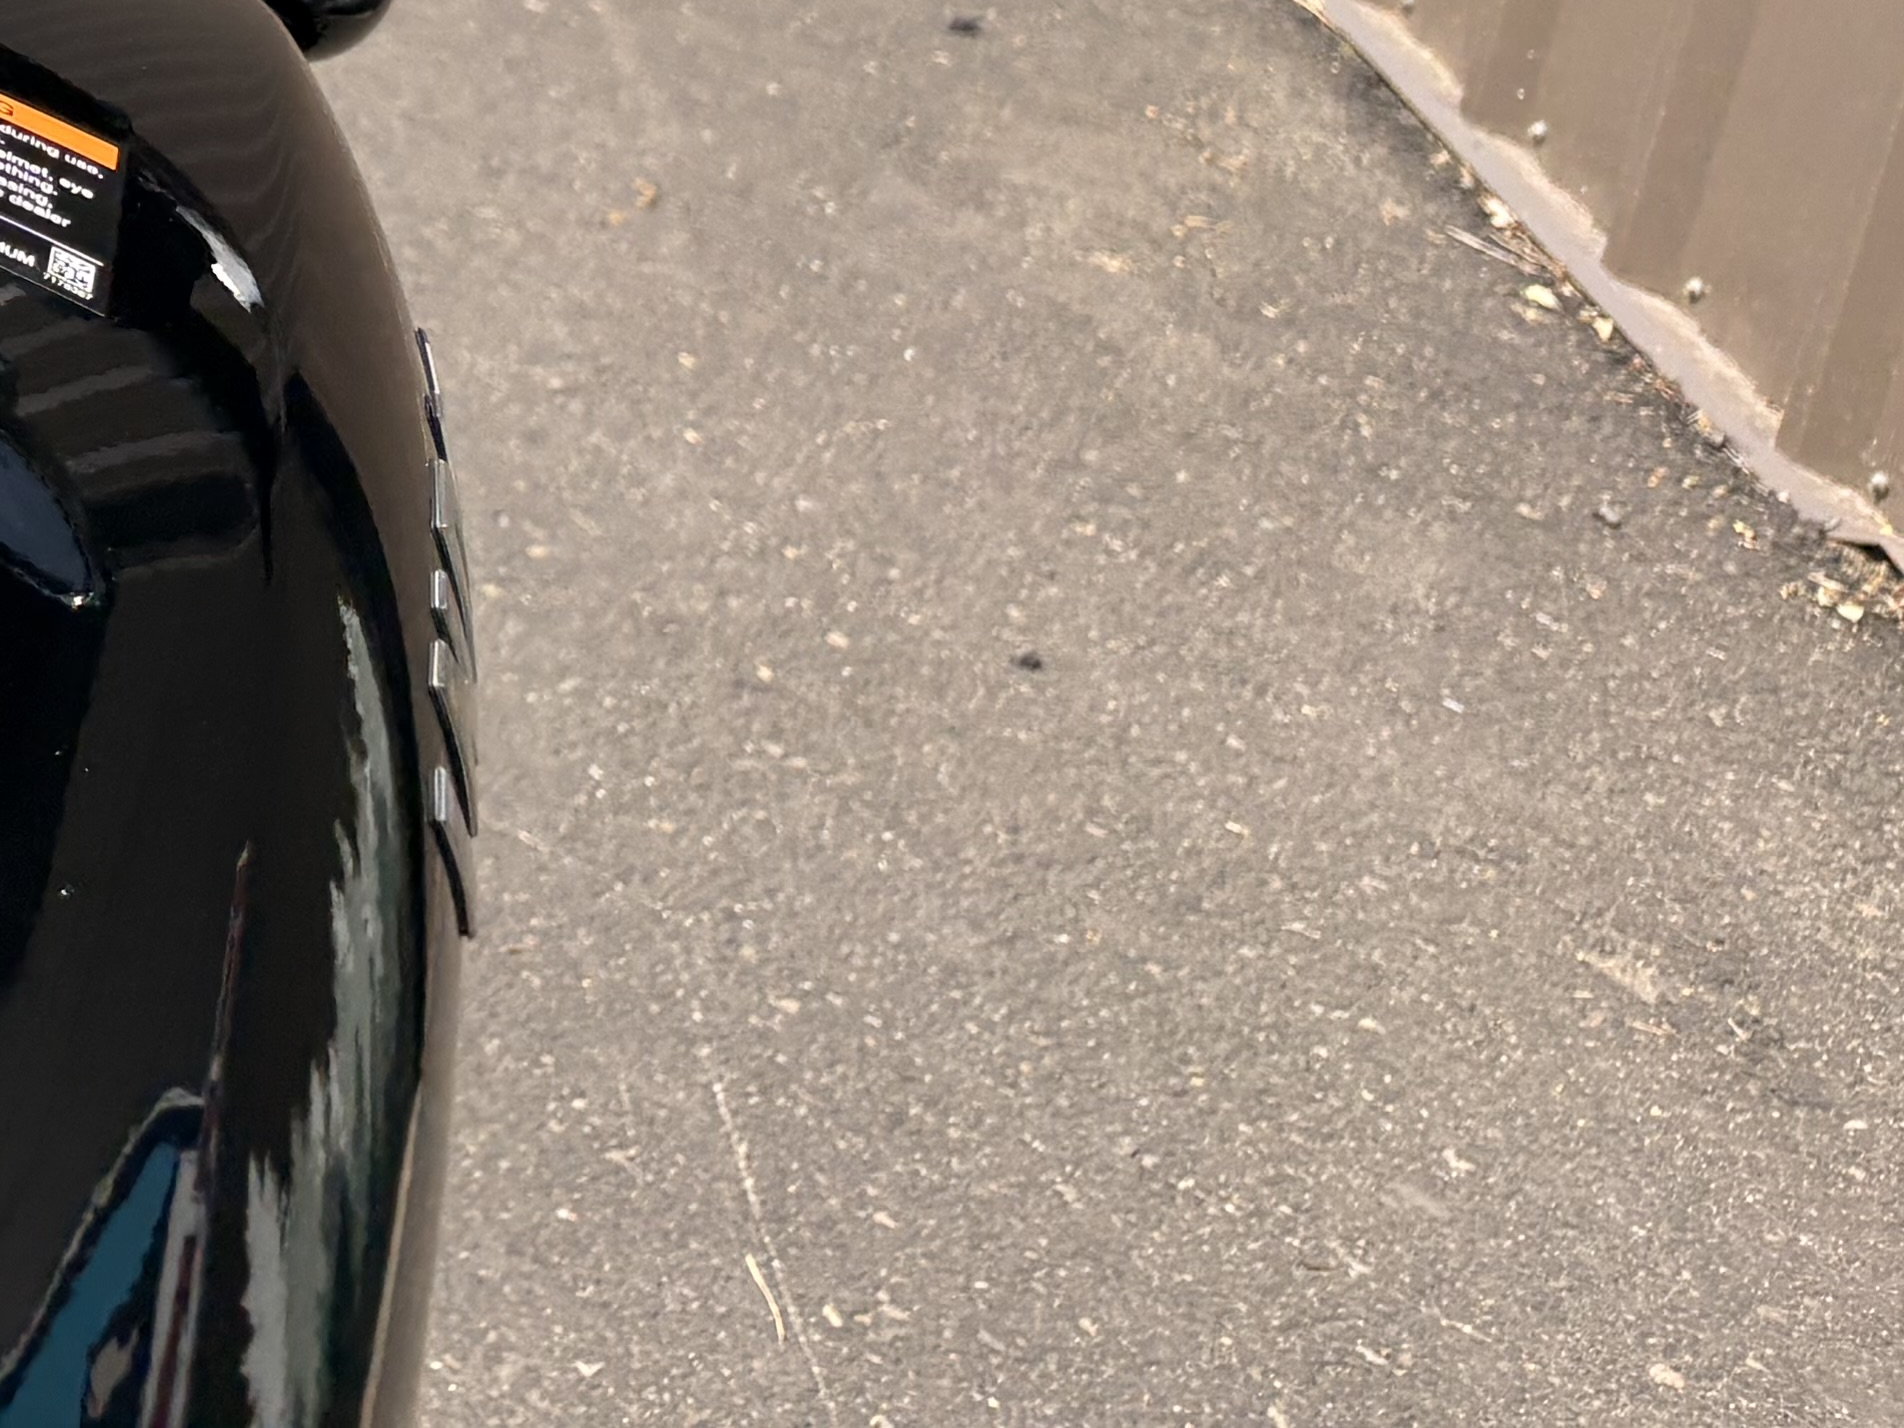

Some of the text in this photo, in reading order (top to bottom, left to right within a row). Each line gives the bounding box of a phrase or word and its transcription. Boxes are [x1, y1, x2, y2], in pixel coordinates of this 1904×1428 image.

[64, 153, 104, 180] use.
[59, 177, 94, 200] eye
[8, 194, 72, 227] dealer
